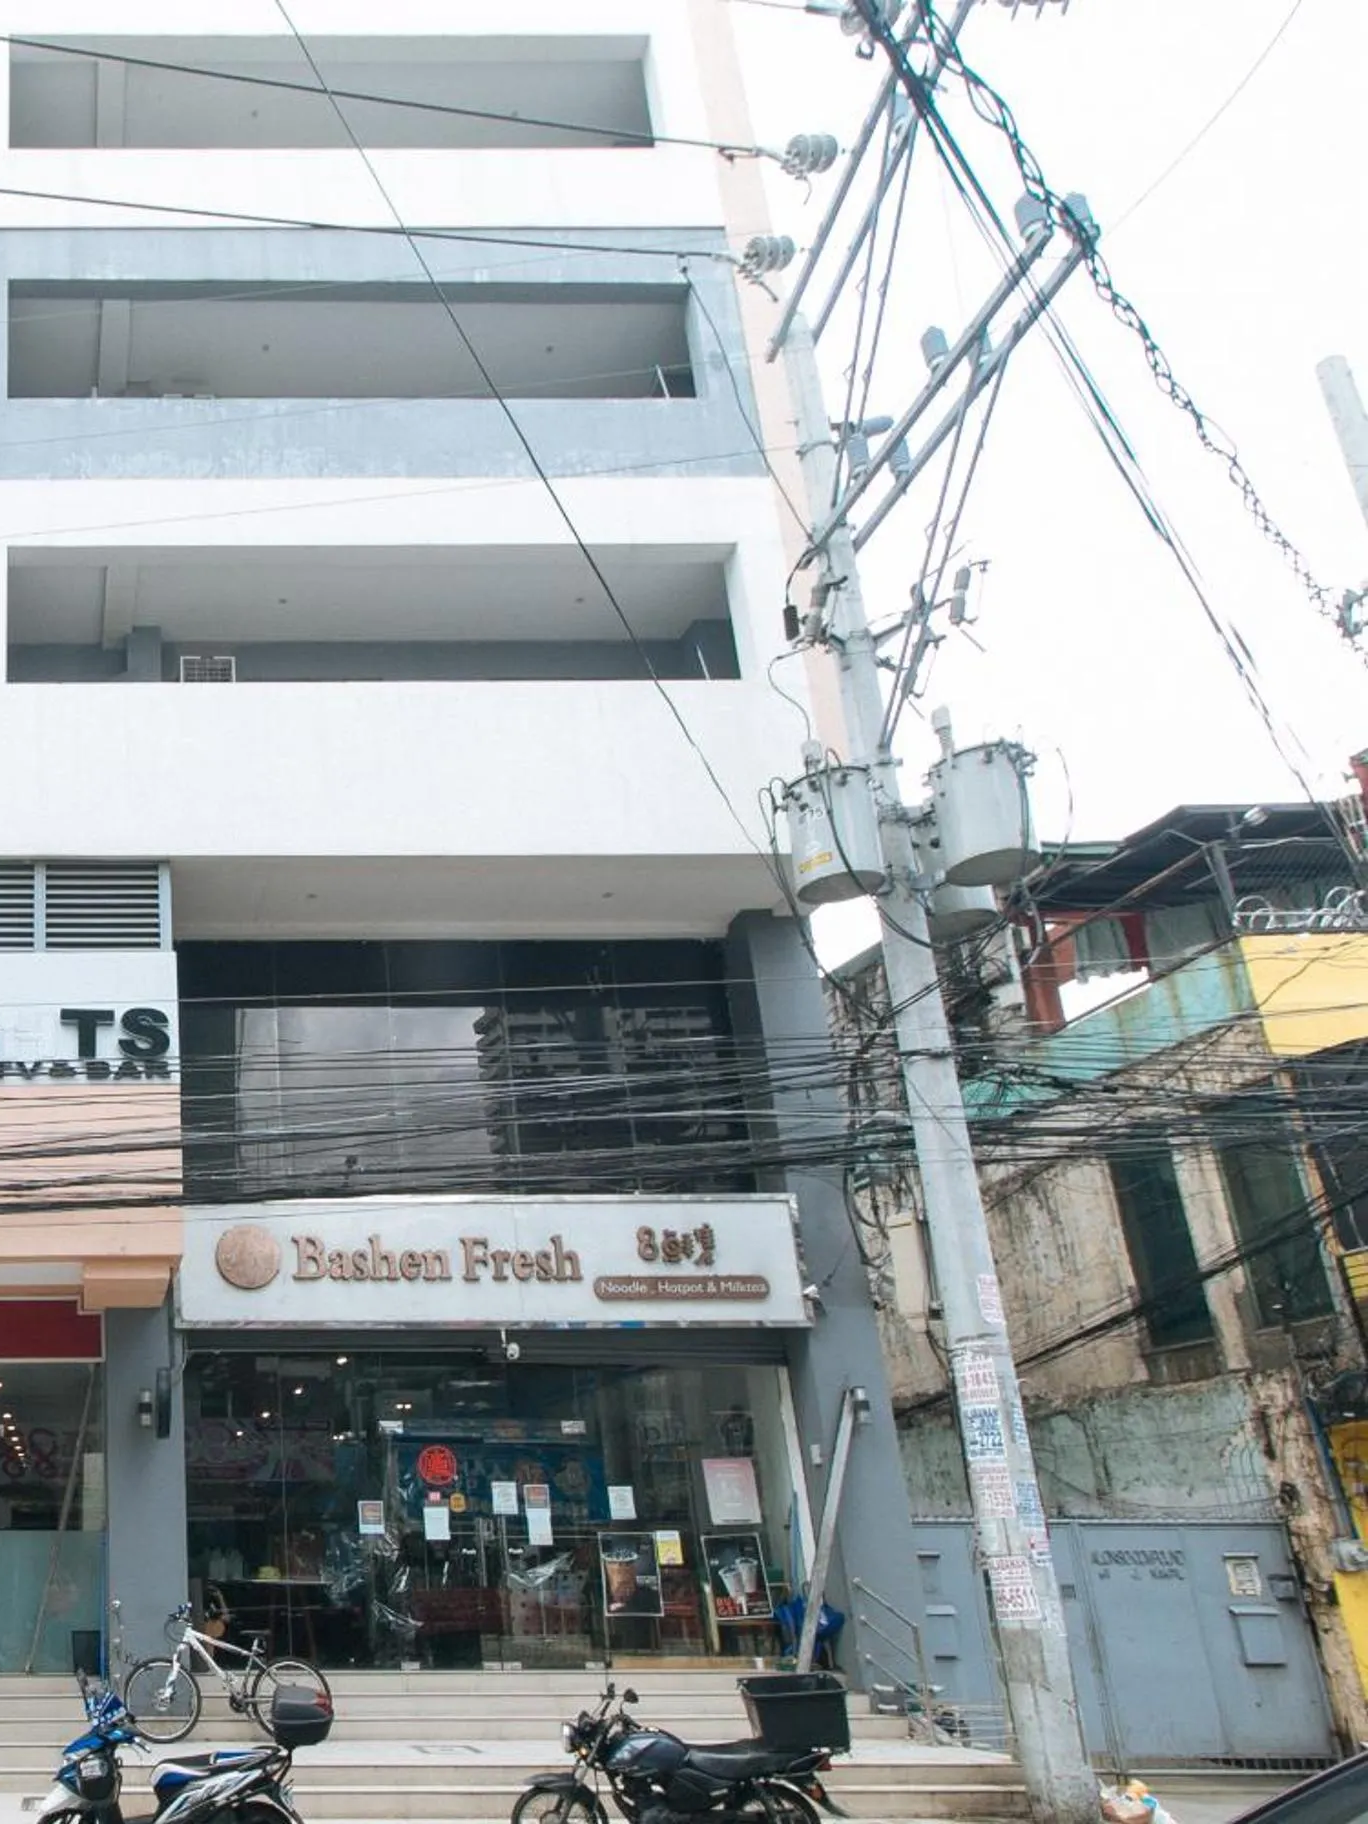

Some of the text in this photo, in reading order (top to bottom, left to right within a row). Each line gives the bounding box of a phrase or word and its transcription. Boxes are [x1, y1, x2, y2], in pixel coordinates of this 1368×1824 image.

[290, 1234, 452, 1282] Bashen
[460, 1234, 585, 1282] Fresh
[600, 1279, 767, 1295] Noodle Hotpot & Milktea
